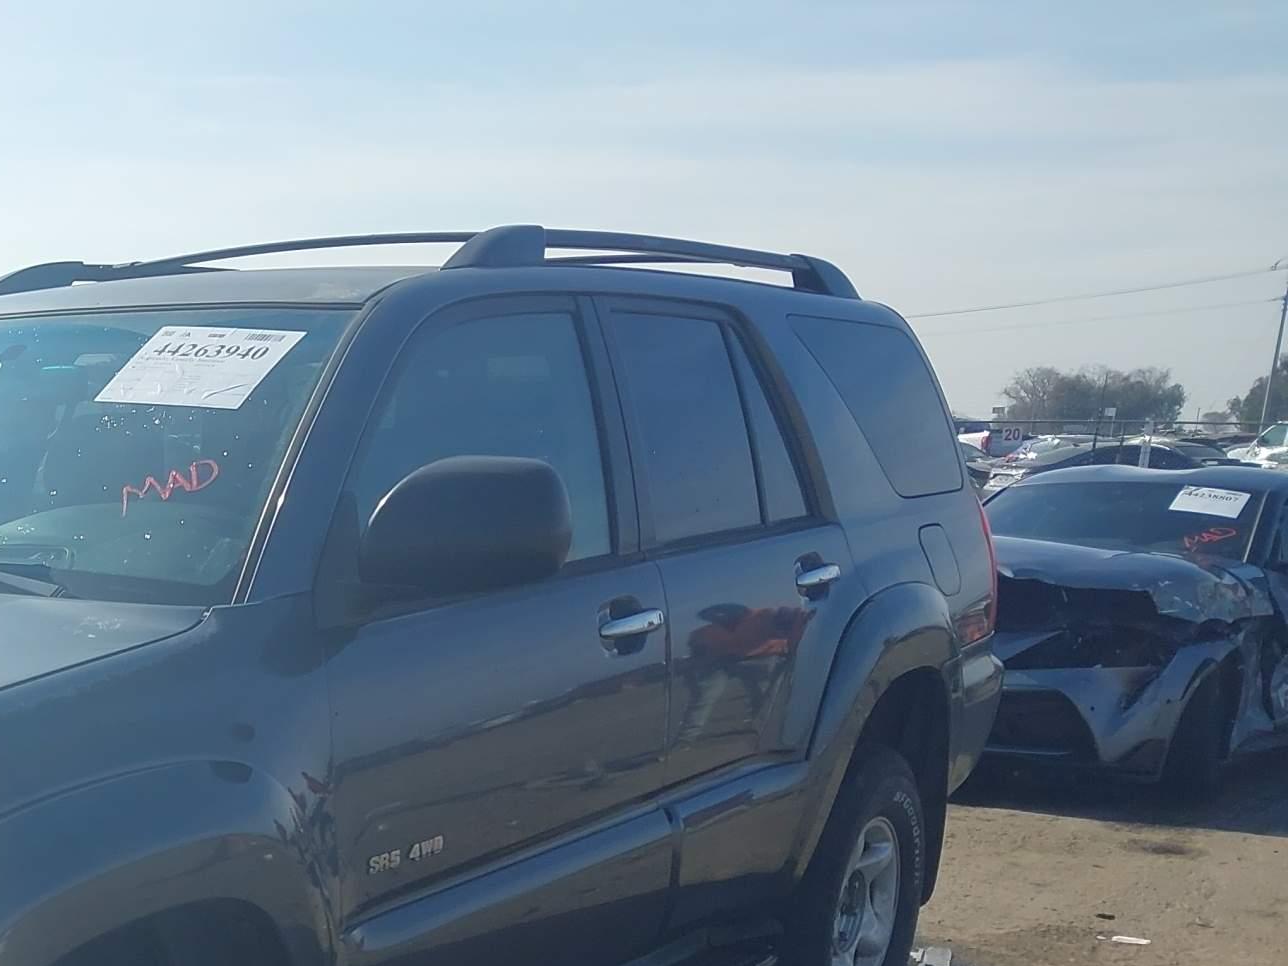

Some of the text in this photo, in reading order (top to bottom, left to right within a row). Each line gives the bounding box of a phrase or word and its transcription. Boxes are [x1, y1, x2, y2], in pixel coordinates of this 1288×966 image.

[153, 342, 270, 361] 44263940
[1004, 427, 1021, 441] 20
[121, 459, 219, 517] MAD
